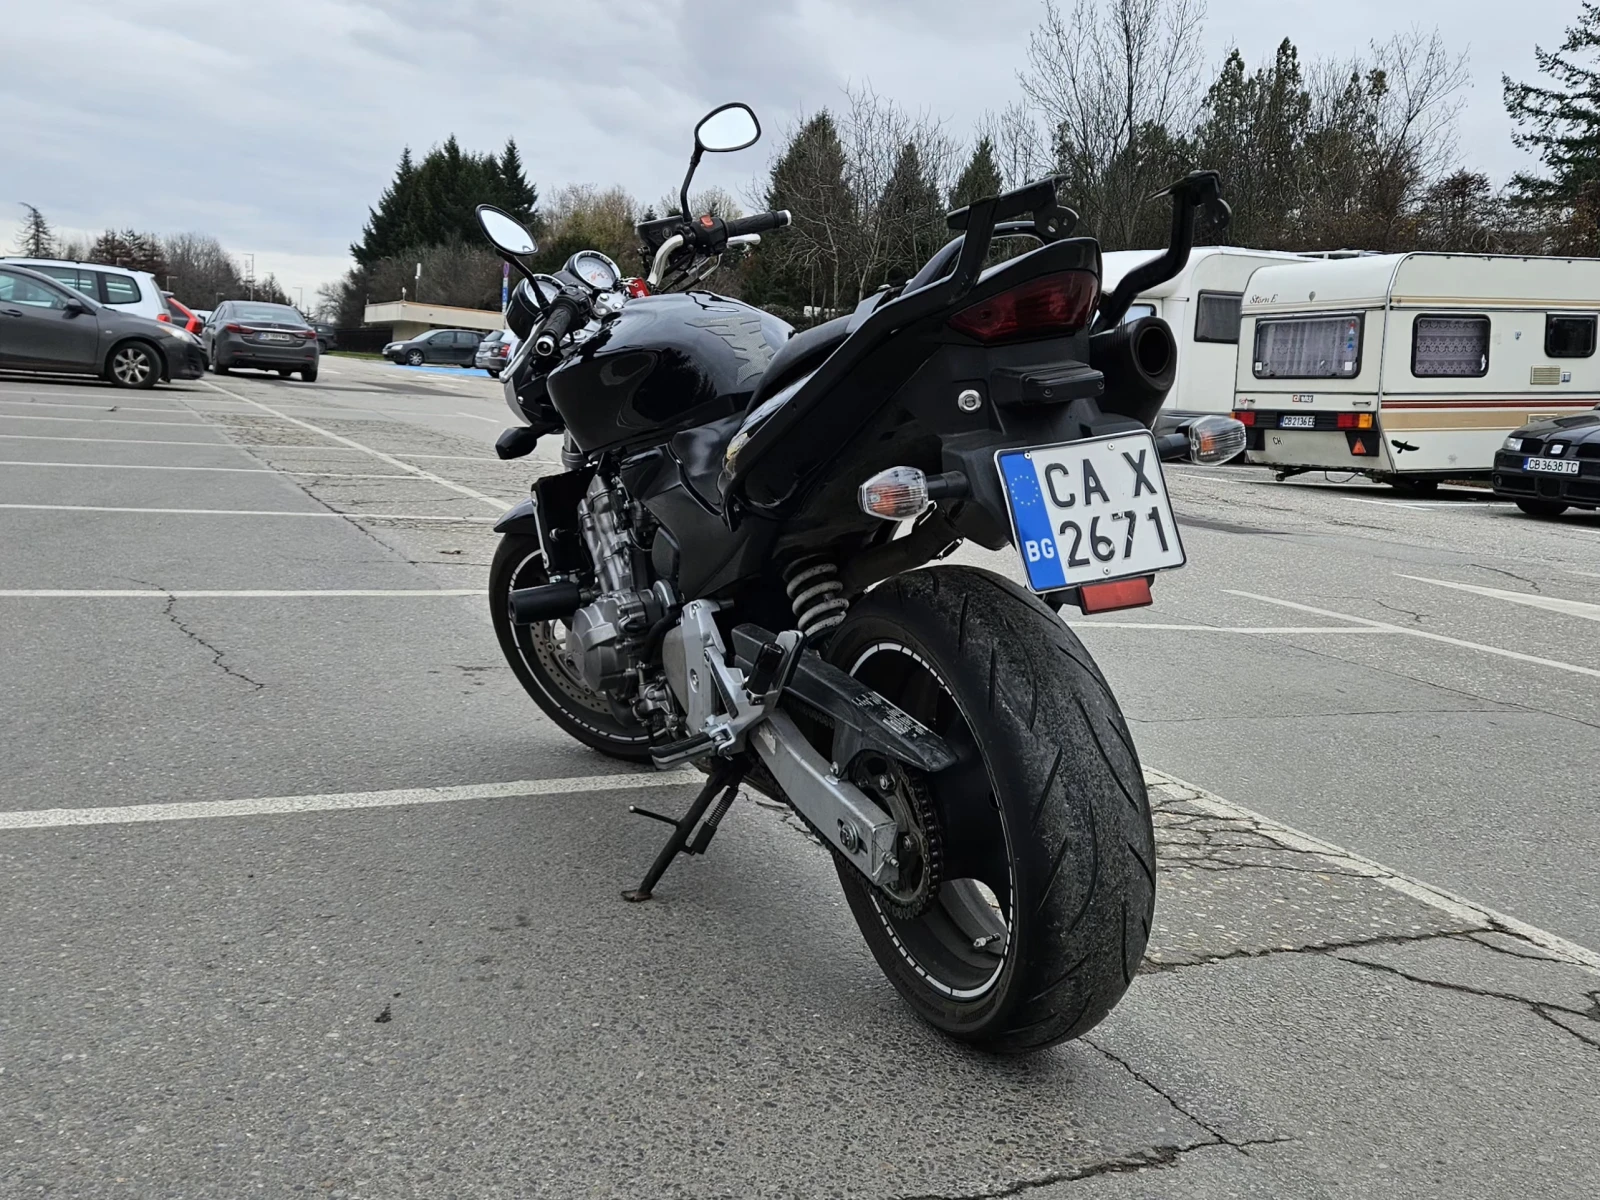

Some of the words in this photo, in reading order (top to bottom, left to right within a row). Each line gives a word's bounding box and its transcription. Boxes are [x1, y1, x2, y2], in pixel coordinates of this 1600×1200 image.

[1044, 458, 1110, 508] CA
[1121, 449, 1157, 498] X
[1541, 460, 1563, 471] 3638
[1565, 462, 1578, 473] TC
[1025, 538, 1055, 562] BG
[1059, 506, 1169, 568] 2671
